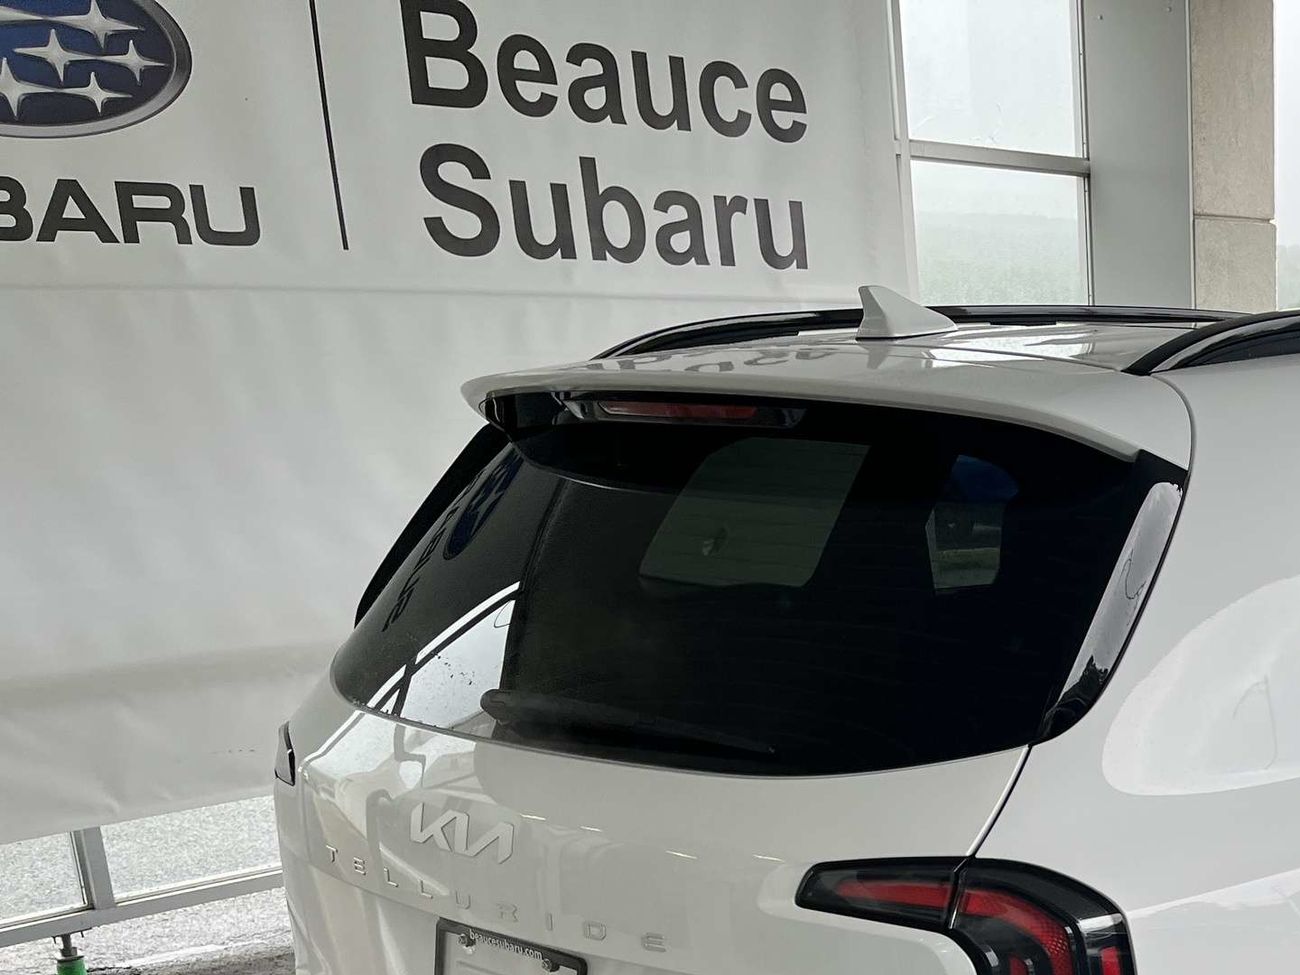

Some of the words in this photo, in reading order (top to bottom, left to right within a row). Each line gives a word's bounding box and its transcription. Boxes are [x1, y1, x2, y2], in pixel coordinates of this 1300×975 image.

[401, 0, 808, 143] Beauce
[420, 143, 809, 270] Subaru
[411, 802, 514, 864] KIA
[326, 845, 668, 953] TELLURIDE
[469, 929, 543, 960] beaucesubaru.com
